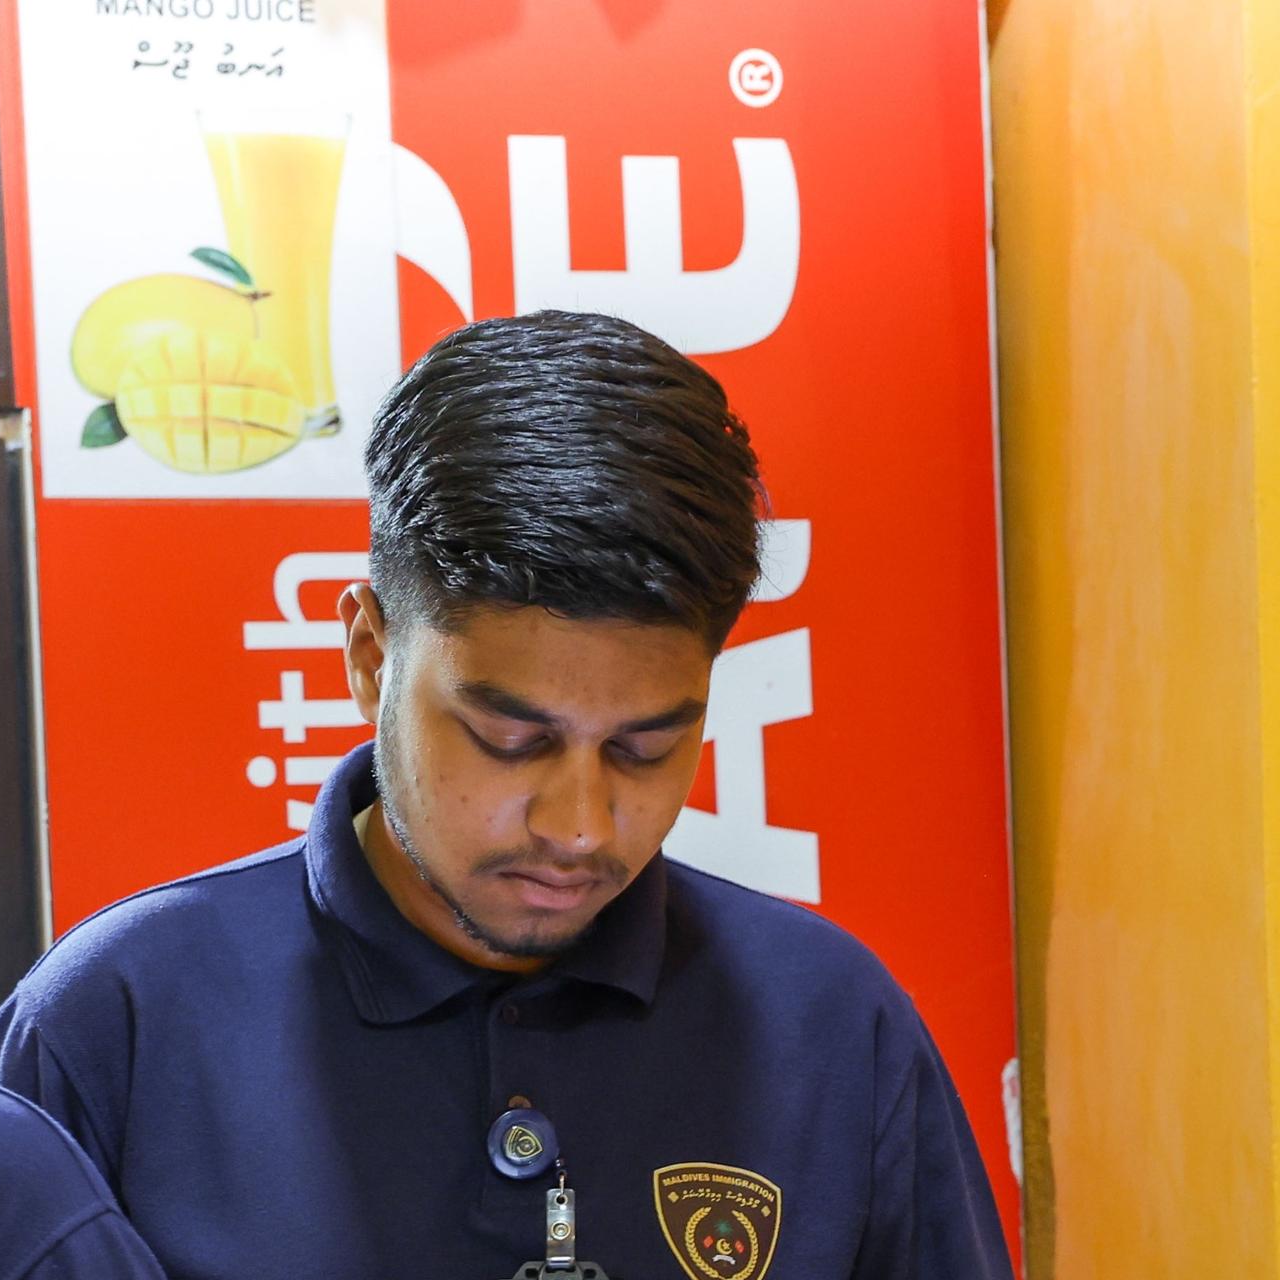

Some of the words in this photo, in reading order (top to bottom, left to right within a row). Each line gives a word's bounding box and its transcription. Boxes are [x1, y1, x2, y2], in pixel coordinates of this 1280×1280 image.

[96, 0, 214, 19] MANGO
[226, 0, 316, 23] JUICE
[243, 551, 370, 832] ith
[662, 1173, 710, 1187] MALDIVES
[711, 1174, 775, 1203] IMMIGRATION
